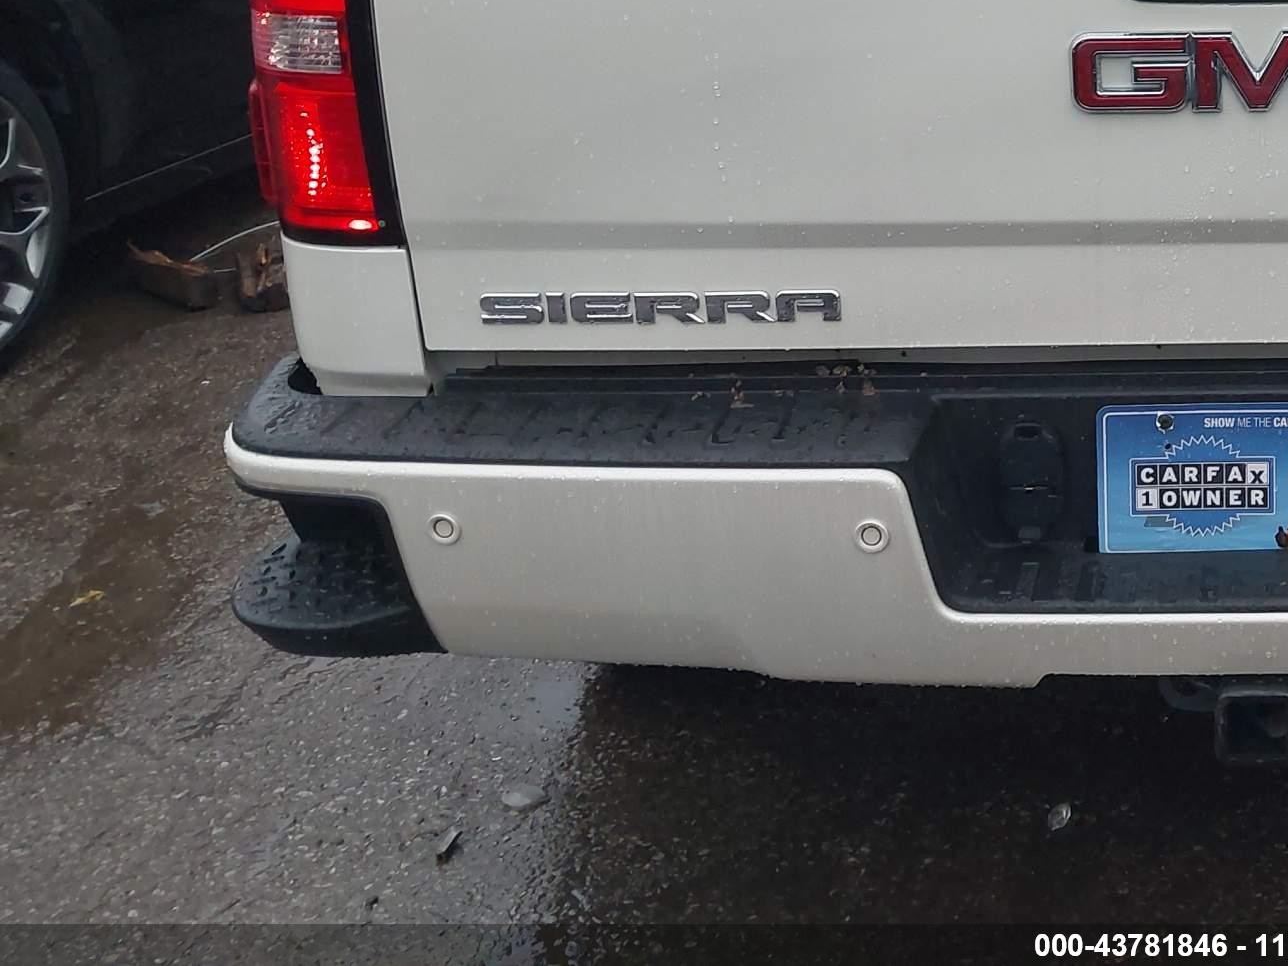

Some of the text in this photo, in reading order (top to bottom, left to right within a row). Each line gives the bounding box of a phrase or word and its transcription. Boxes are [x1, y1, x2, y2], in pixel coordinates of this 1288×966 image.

[479, 289, 842, 324] SIERRA
[1203, 417, 1236, 428] SHOW
[1237, 417, 1252, 428] ME
[1253, 417, 1272, 428] THE
[1140, 465, 1266, 484] CARFAX
